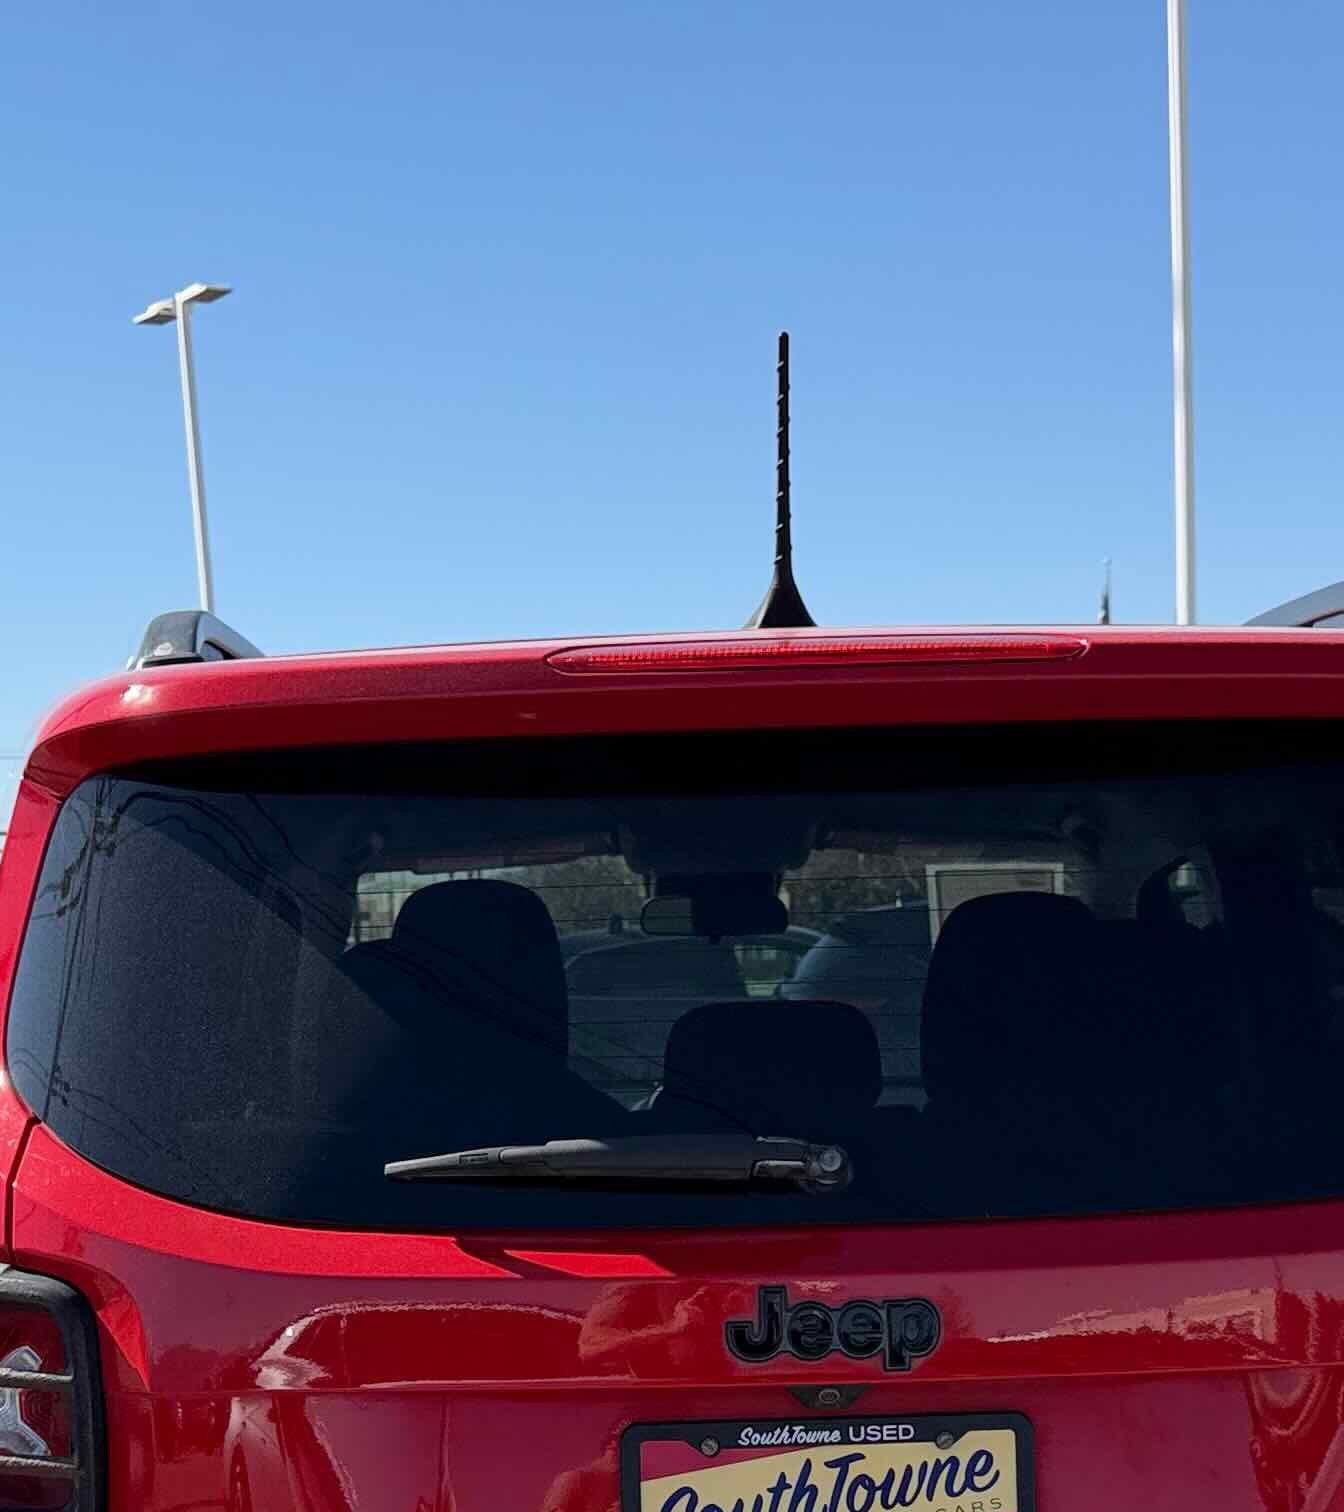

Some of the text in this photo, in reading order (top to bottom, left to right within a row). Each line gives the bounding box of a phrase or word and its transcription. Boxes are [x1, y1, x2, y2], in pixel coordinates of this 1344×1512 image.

[725, 1284, 941, 1372] Jeep
[737, 1424, 915, 1446] SouthTowne USED
